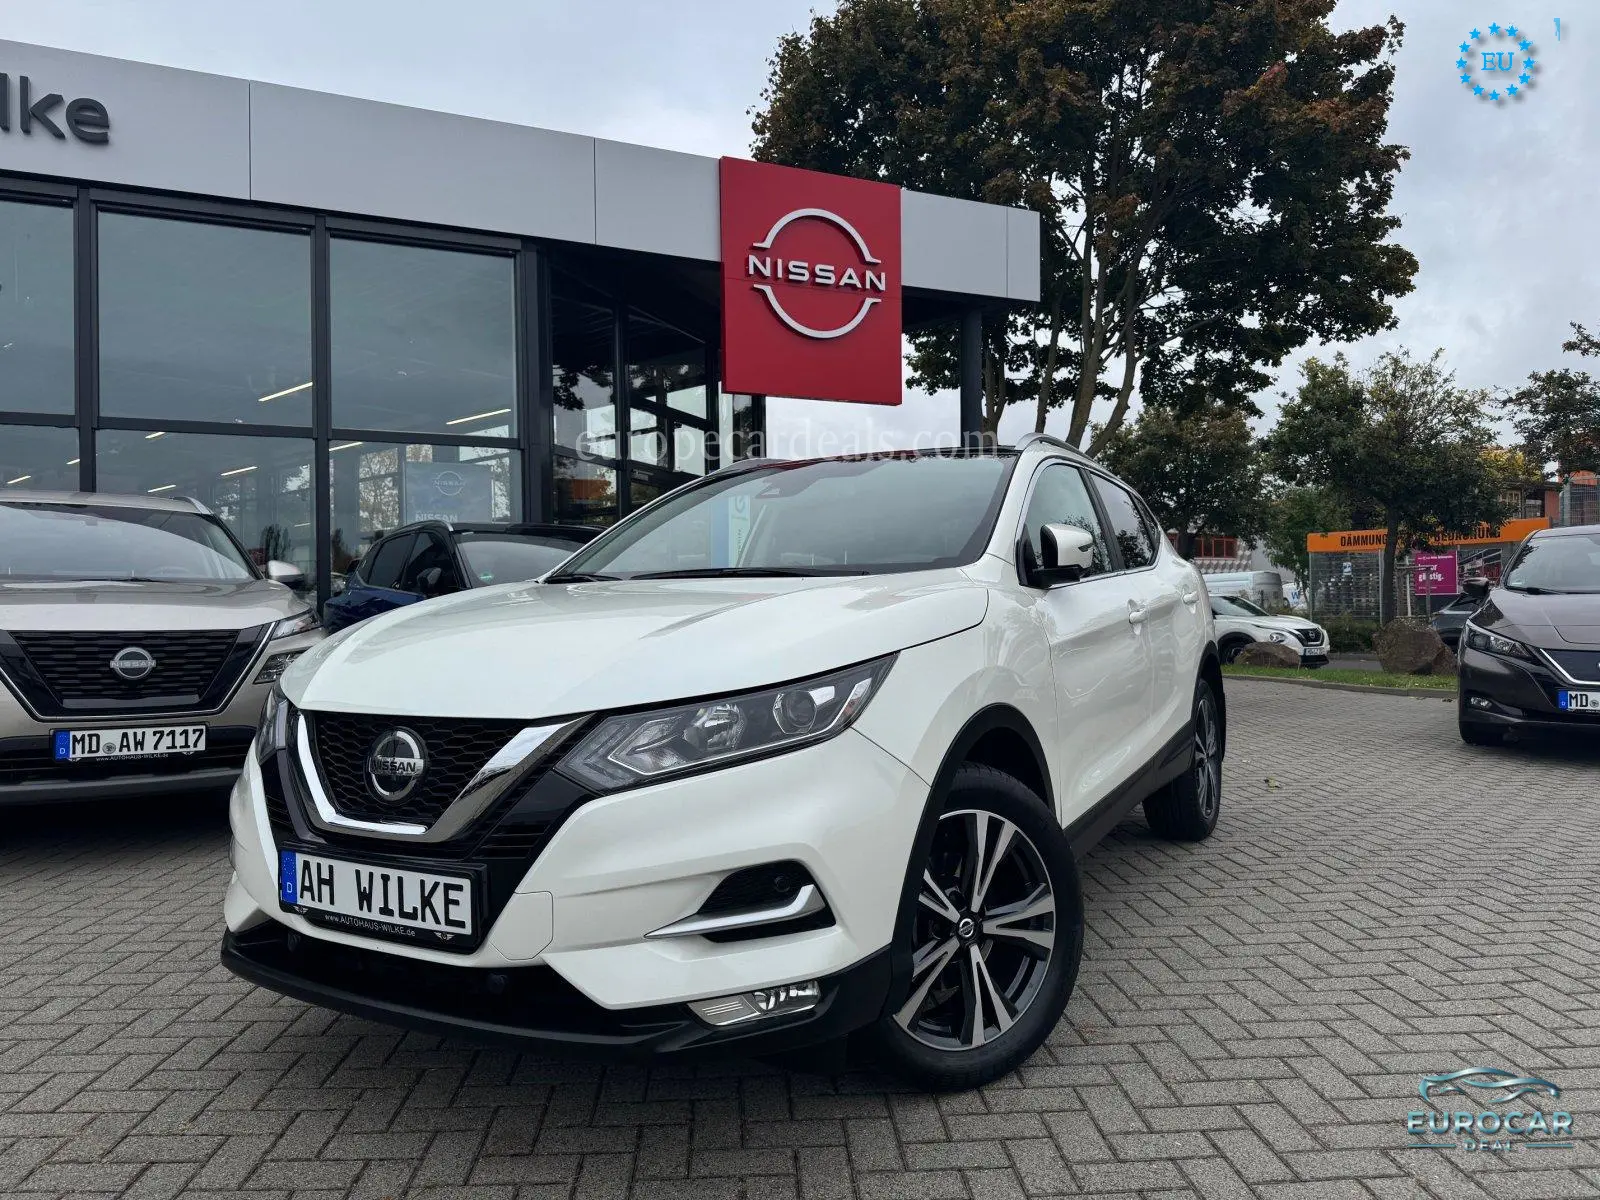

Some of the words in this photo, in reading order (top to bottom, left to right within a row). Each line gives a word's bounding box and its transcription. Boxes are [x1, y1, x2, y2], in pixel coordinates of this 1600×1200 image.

[748, 254, 886, 291] NISSAN
[415, 513, 458, 522] NISSAN
[111, 661, 155, 669] NISSAN
[1568, 693, 1589, 708] MD
[71, 733, 101, 756] MD
[118, 731, 146, 753] AW
[152, 728, 205, 751] 7117
[286, 882, 293, 894] D
[299, 859, 335, 906] AH
[354, 868, 467, 929] WILKE
[324, 913, 416, 937] www.AUTOHAUS-WILKE.de
